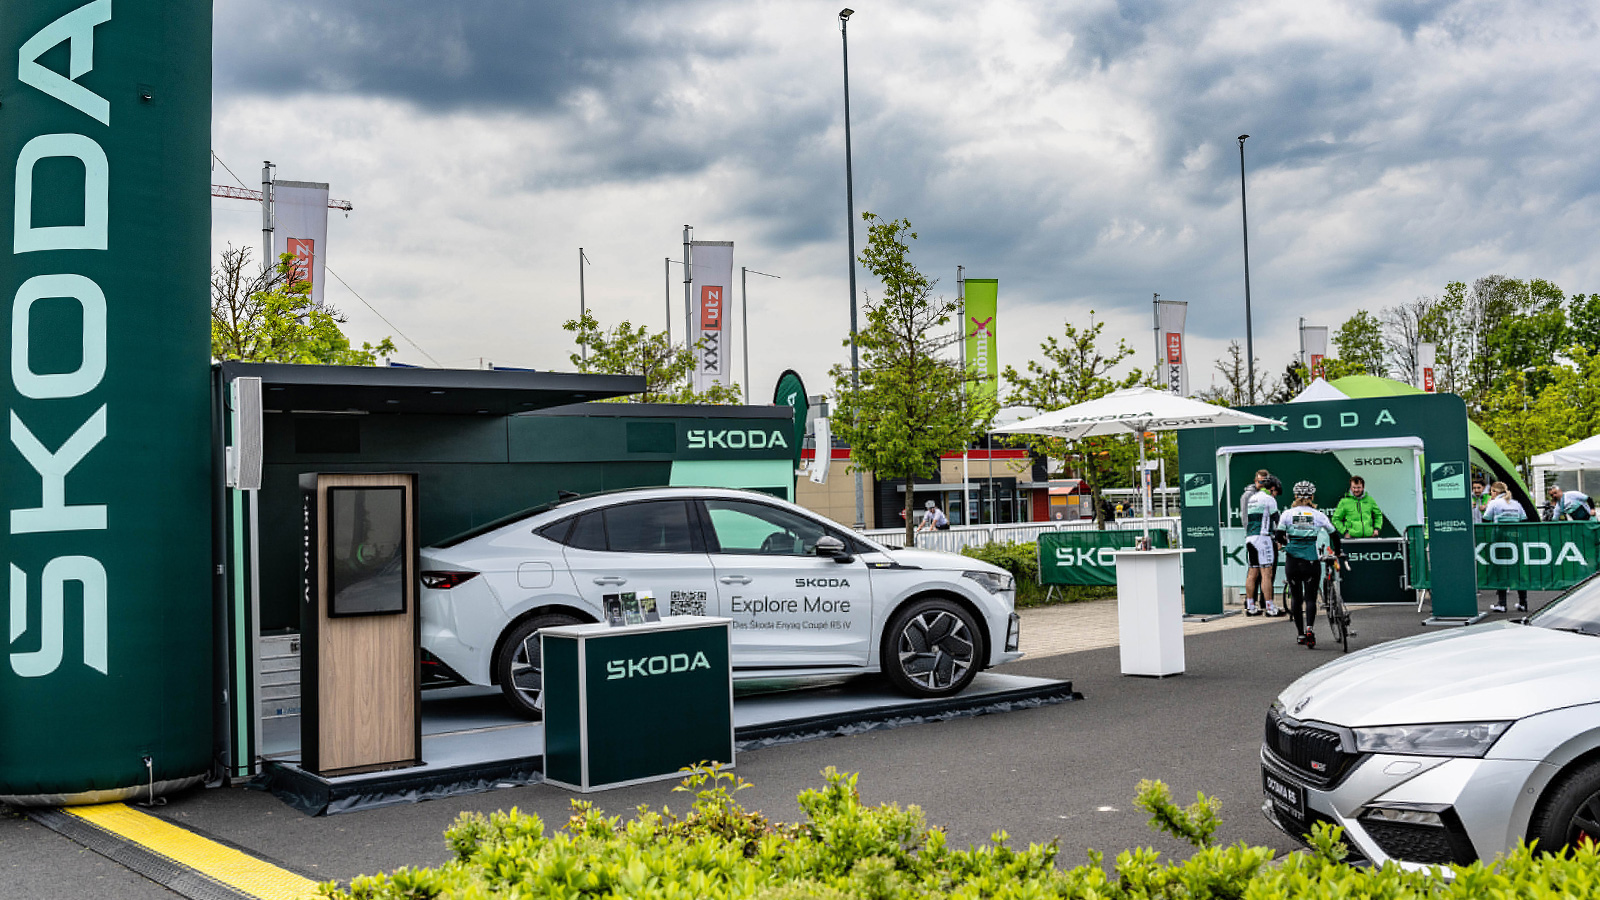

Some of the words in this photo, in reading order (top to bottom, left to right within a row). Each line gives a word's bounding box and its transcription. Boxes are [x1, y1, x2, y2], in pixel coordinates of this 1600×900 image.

[1056, 547, 1117, 566] SKO
[1475, 542, 1588, 566] KODA
[731, 596, 797, 616] Explore
[804, 596, 851, 613] More
